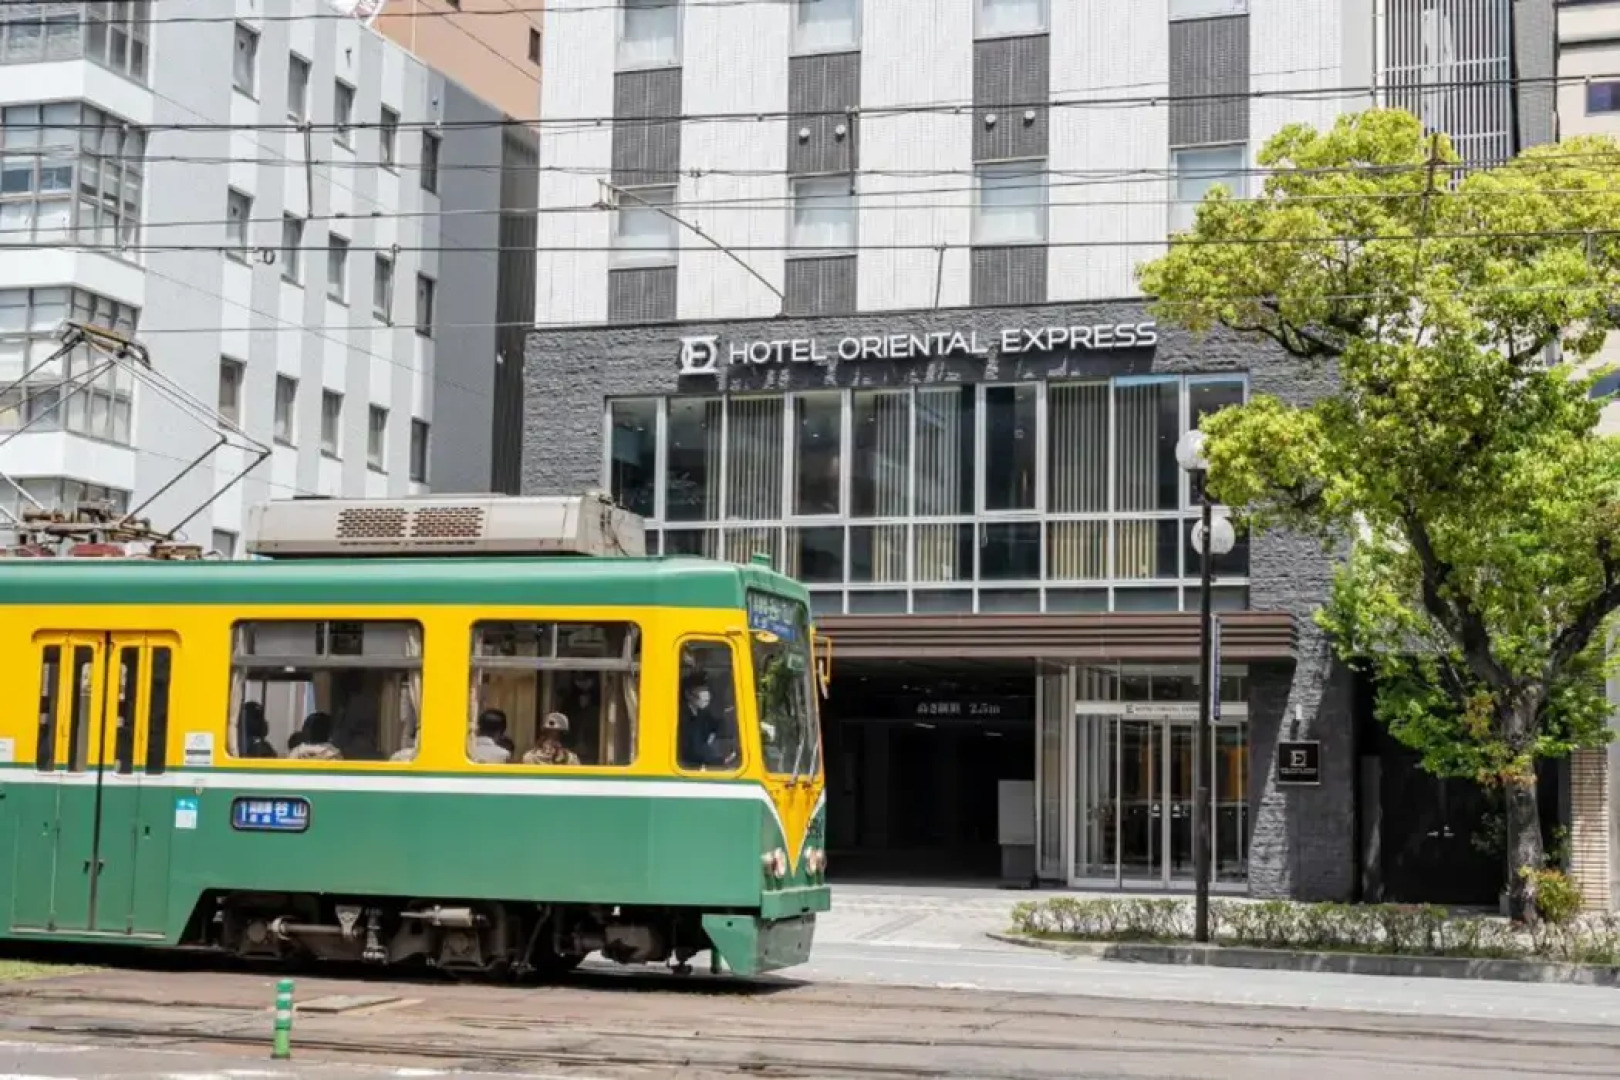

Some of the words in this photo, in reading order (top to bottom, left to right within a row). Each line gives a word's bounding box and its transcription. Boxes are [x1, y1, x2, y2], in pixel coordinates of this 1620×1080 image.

[729, 340, 827, 365] HOTEL
[838, 331, 988, 359] ORIENTAL
[1001, 322, 1157, 353] EXPRESS
